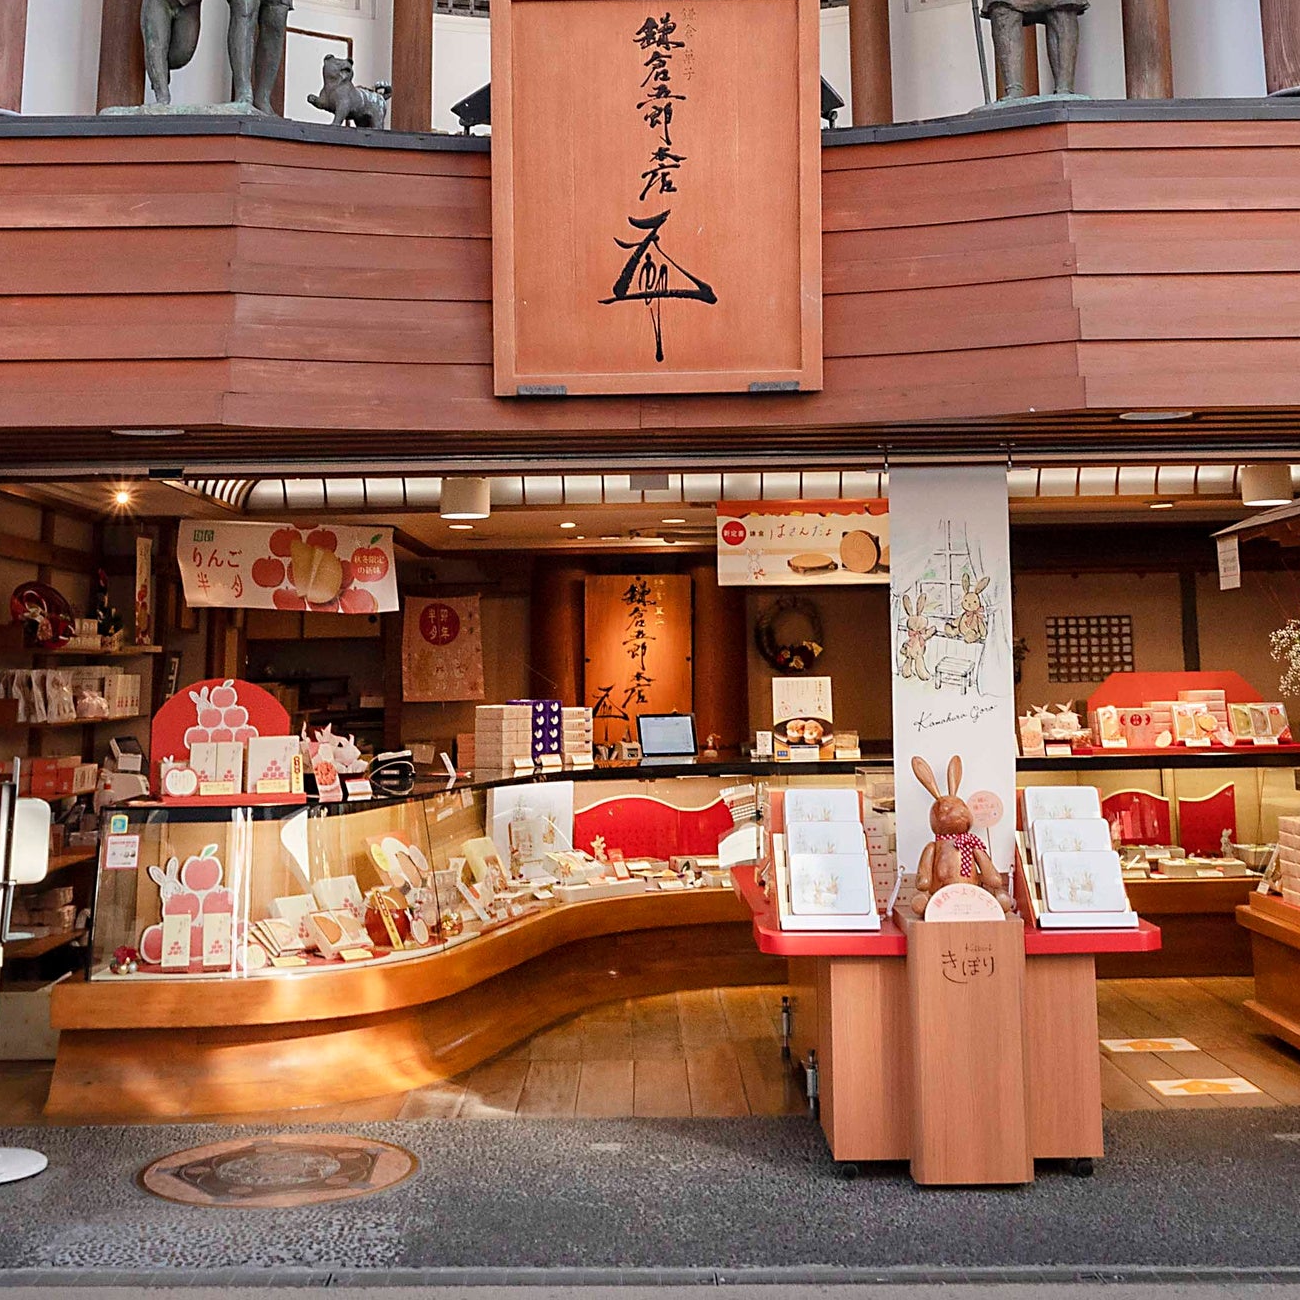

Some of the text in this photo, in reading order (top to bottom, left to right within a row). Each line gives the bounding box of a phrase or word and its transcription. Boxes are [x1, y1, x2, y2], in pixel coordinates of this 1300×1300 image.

[192, 547, 243, 568] りんご
[354, 554, 385, 564] 秋冬限定
[197, 572, 243, 598] 半月
[941, 950, 995, 984] きぼり
